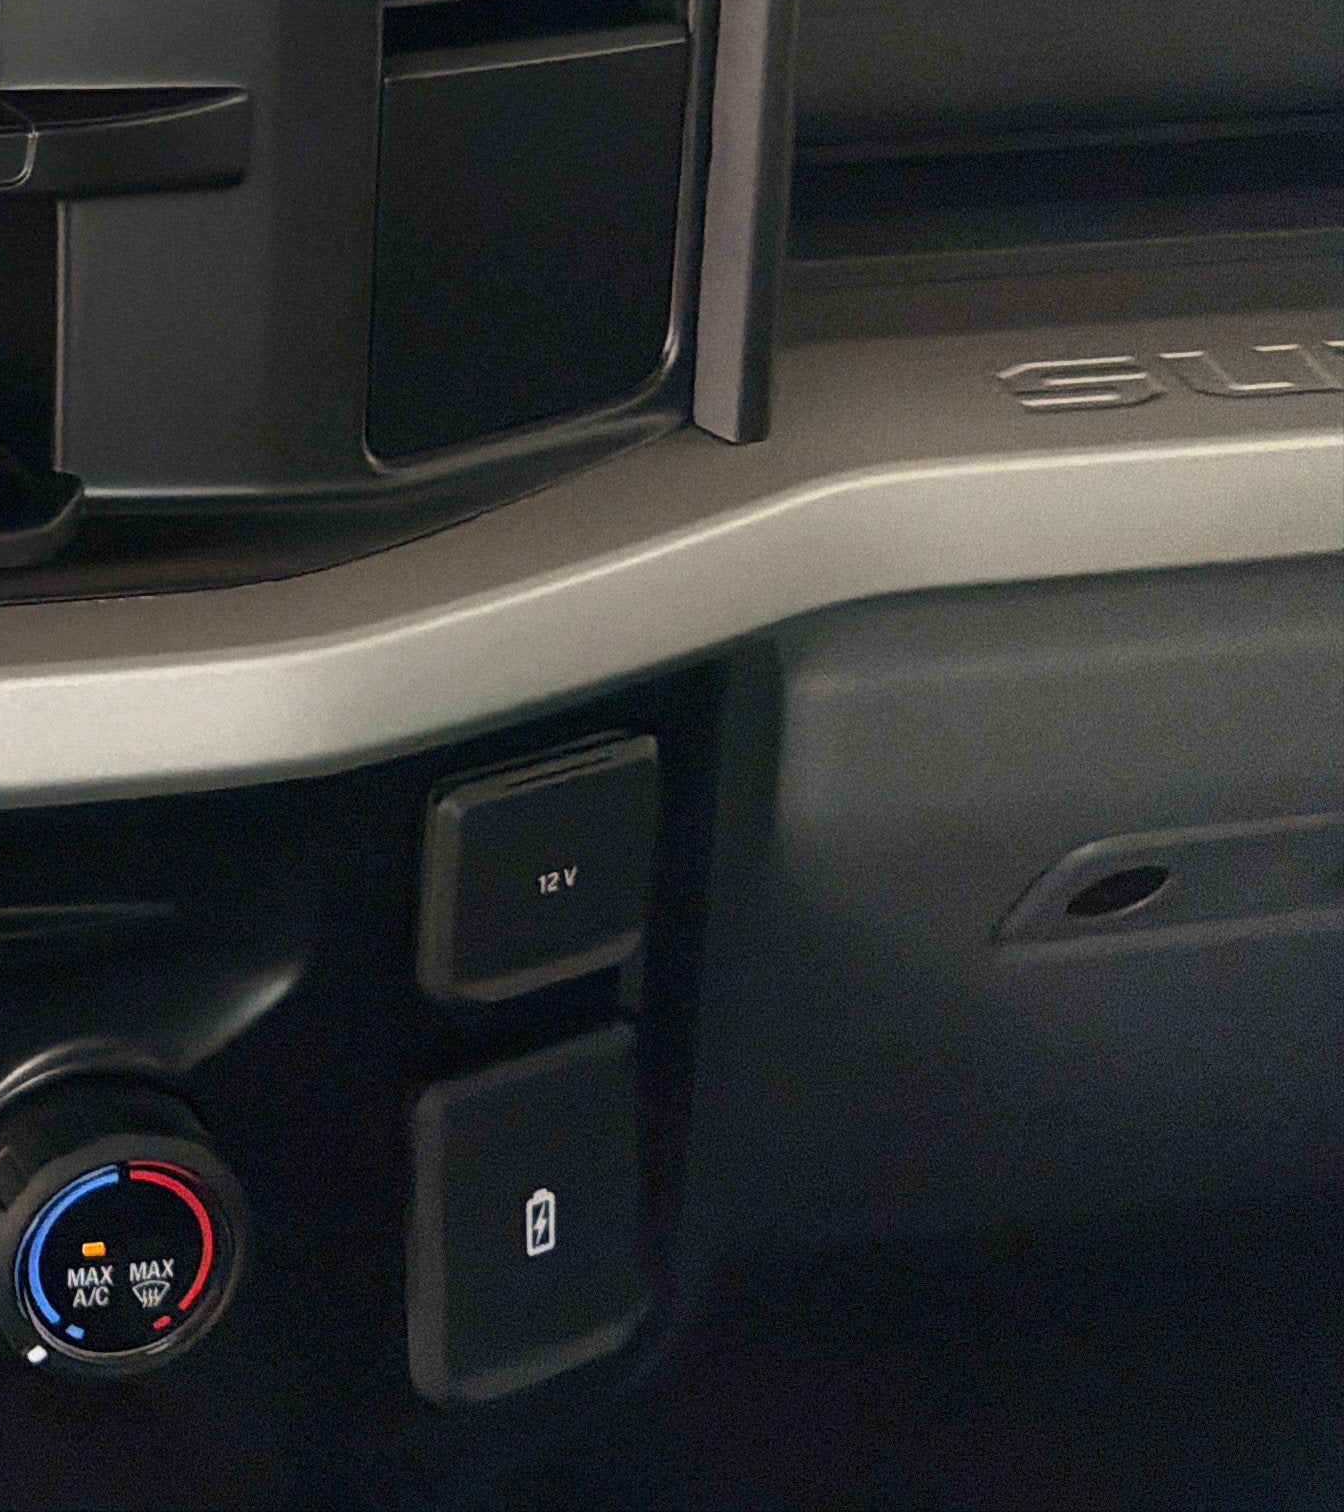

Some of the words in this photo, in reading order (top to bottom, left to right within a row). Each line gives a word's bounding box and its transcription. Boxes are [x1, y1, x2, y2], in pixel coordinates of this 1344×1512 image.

[996, 338, 1344, 414] SU
[538, 871, 560, 894] 12
[563, 865, 579, 887] V
[67, 1264, 113, 1289] MAX
[128, 1258, 175, 1282] MAX
[72, 1285, 110, 1308] A/C
